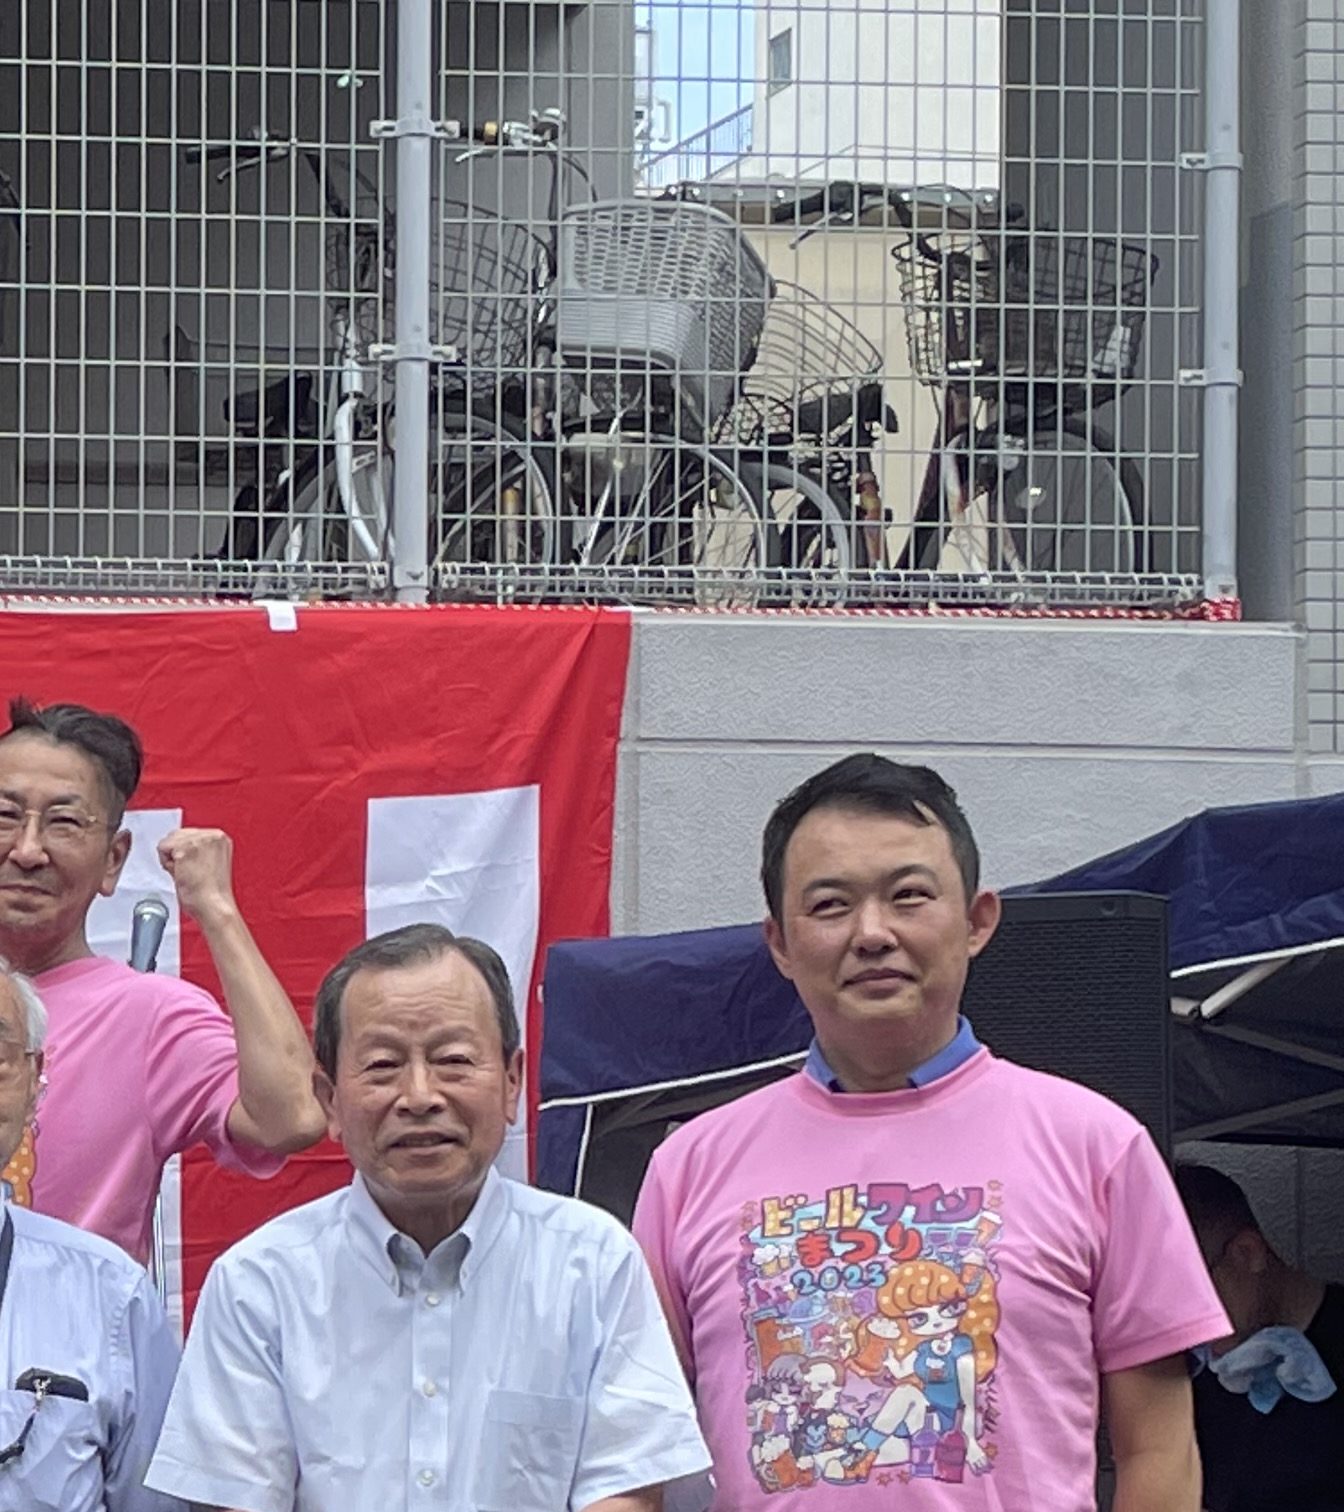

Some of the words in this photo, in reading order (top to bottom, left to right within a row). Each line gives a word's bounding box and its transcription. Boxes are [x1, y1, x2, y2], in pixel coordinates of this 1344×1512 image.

[761, 1183, 984, 1237] ビールワイン
[796, 1220, 923, 1267] まつり
[791, 1263, 887, 1295] 2023
